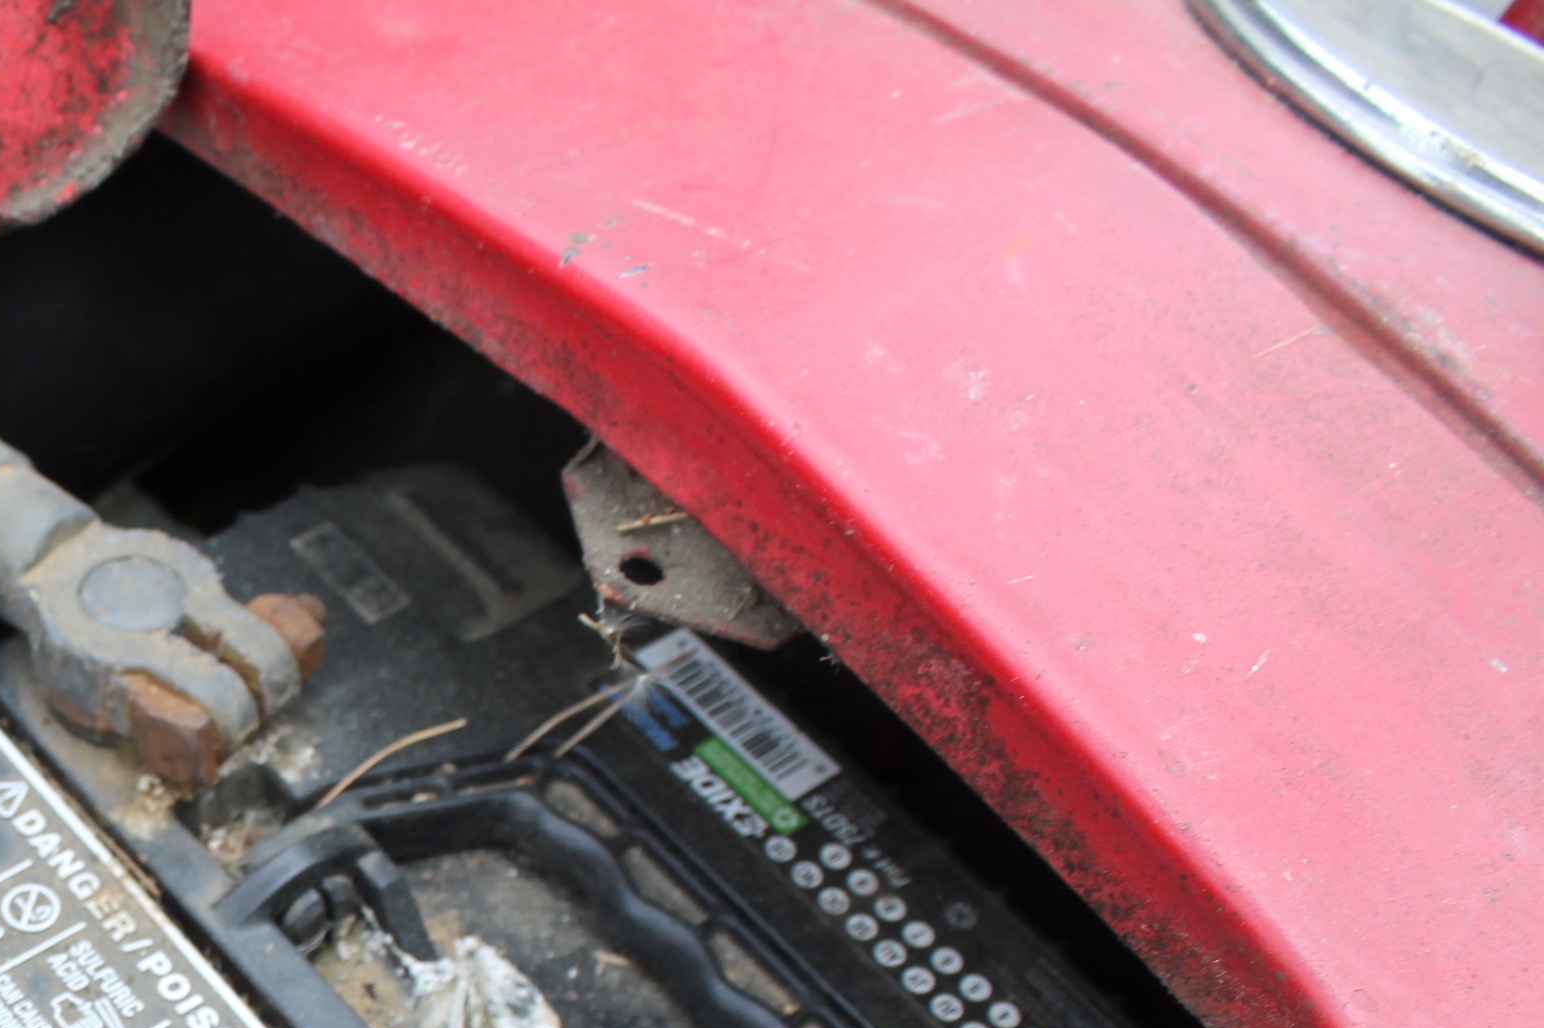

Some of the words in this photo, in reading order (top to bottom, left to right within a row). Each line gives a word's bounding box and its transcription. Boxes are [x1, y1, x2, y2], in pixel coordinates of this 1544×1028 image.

[670, 755, 769, 840] EXIDE
[45, 950, 91, 992] ACID
[67, 938, 145, 1018] SULFURIC
